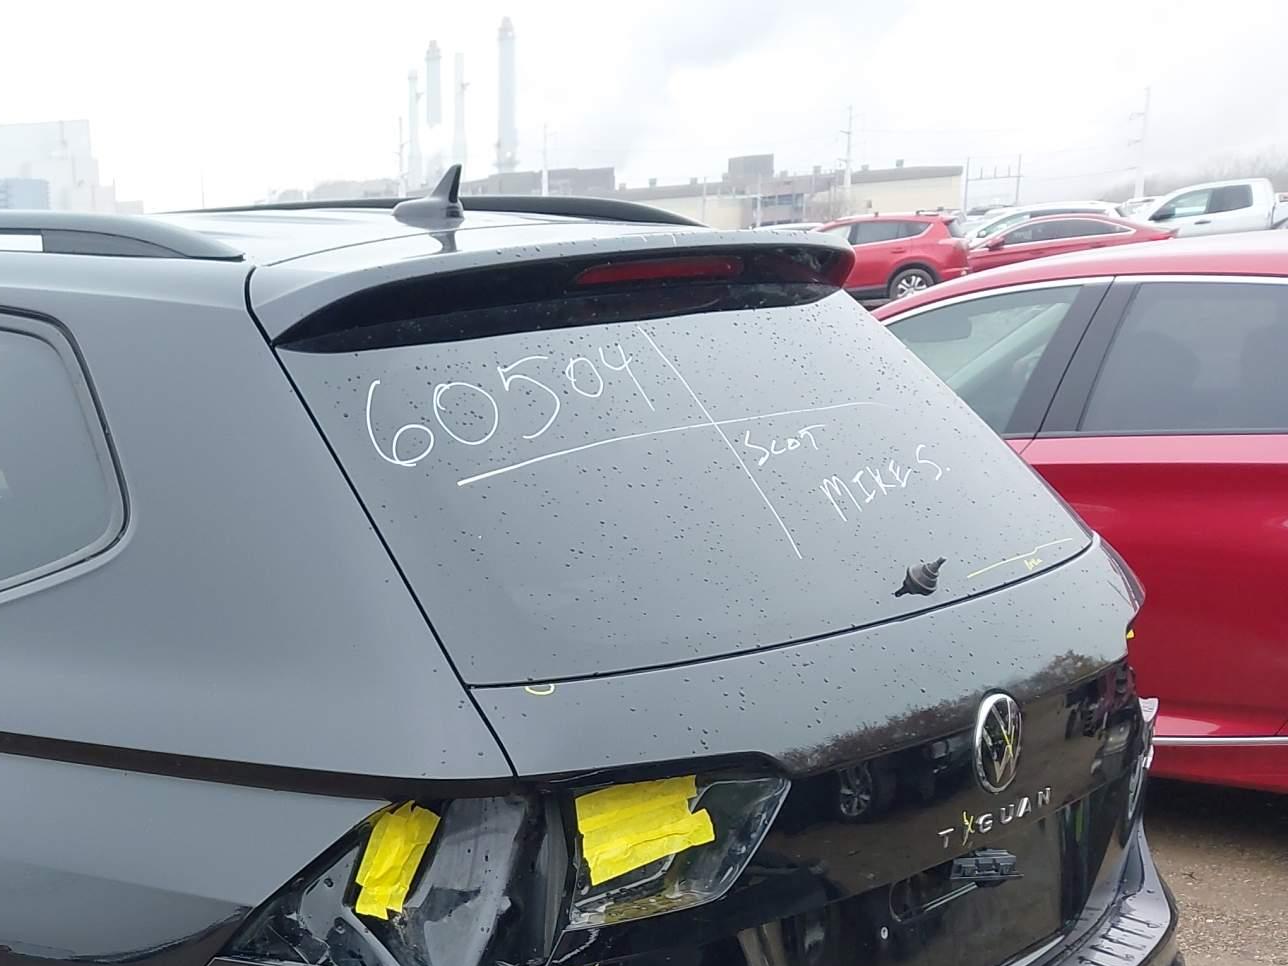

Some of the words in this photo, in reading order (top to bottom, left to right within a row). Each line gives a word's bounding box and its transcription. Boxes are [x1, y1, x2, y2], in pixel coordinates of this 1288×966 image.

[367, 342, 655, 467] 60504
[745, 424, 826, 466] SCOT
[820, 460, 912, 522] MIKE
